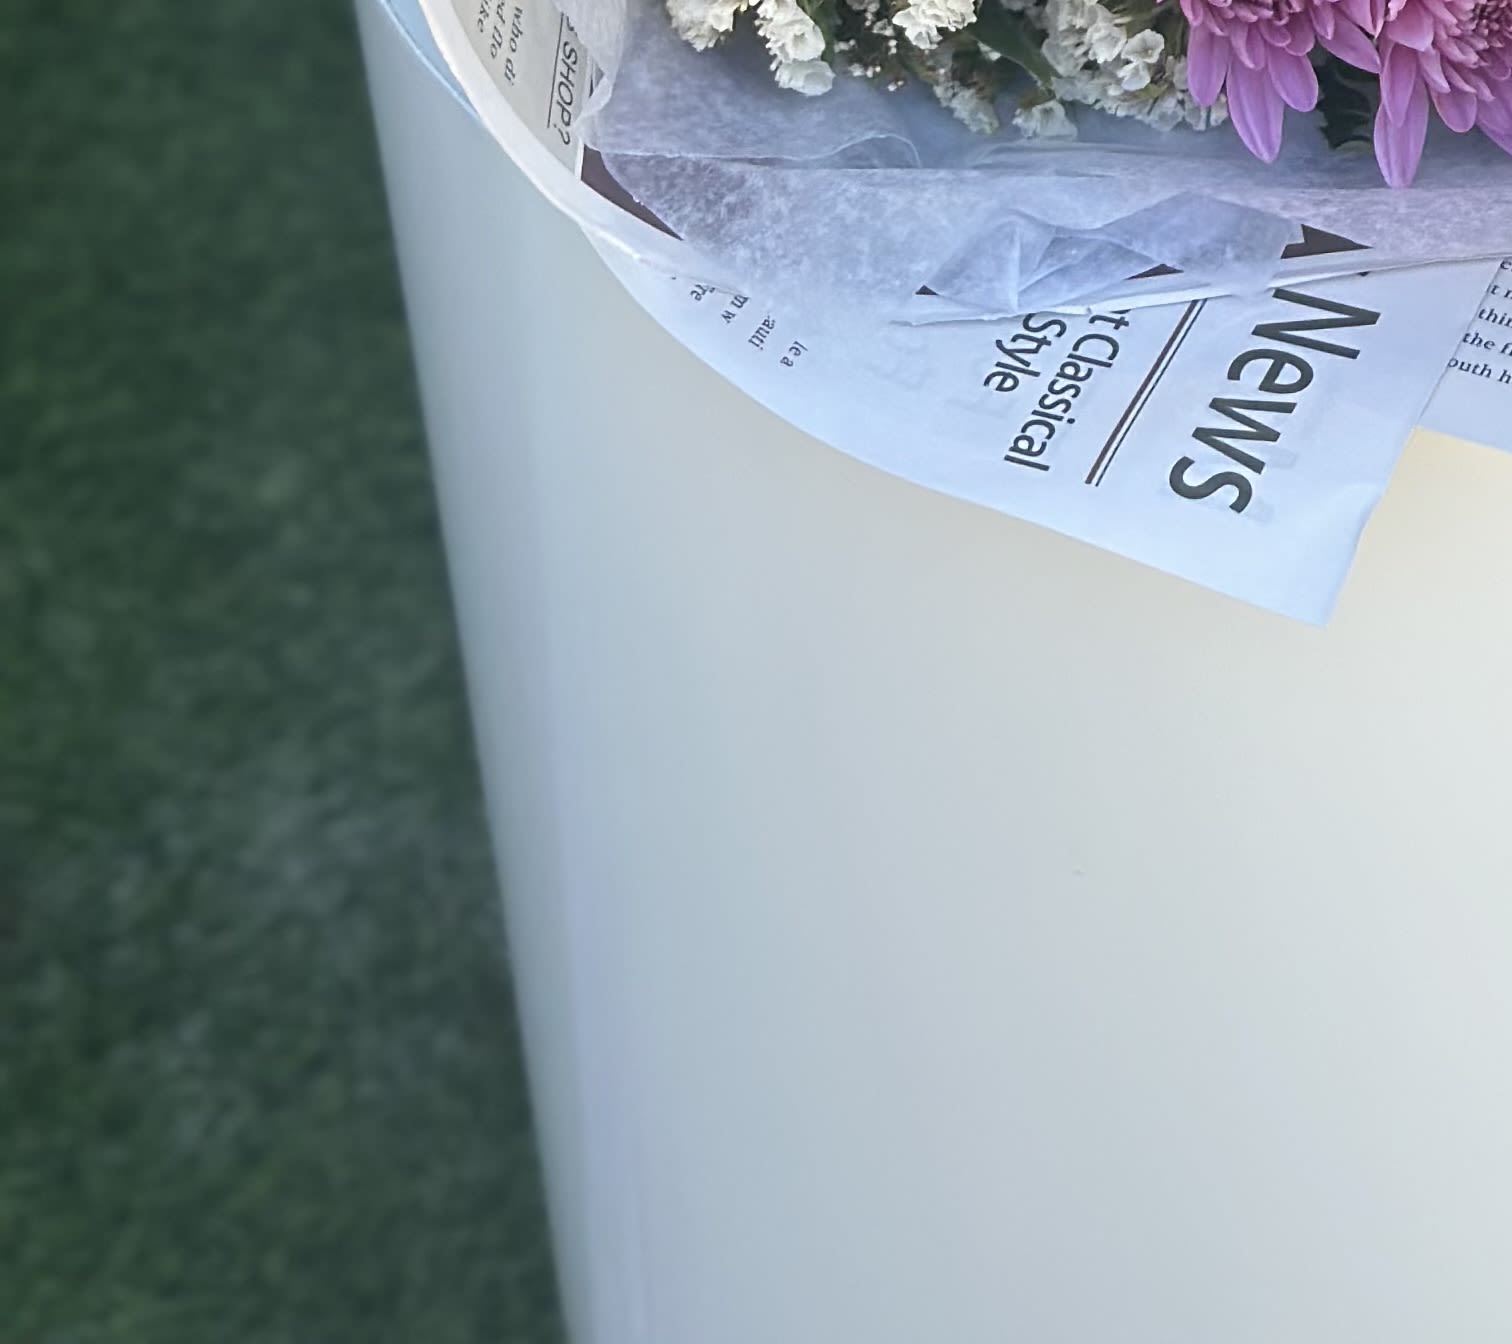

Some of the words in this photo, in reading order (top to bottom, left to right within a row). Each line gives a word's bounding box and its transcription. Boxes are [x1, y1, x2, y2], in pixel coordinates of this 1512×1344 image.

[554, 40, 579, 146] SHOP?
[983, 312, 1068, 394] Style
[1462, 330, 1497, 353] the
[1003, 333, 1120, 472] Classical
[1168, 287, 1382, 515] News
